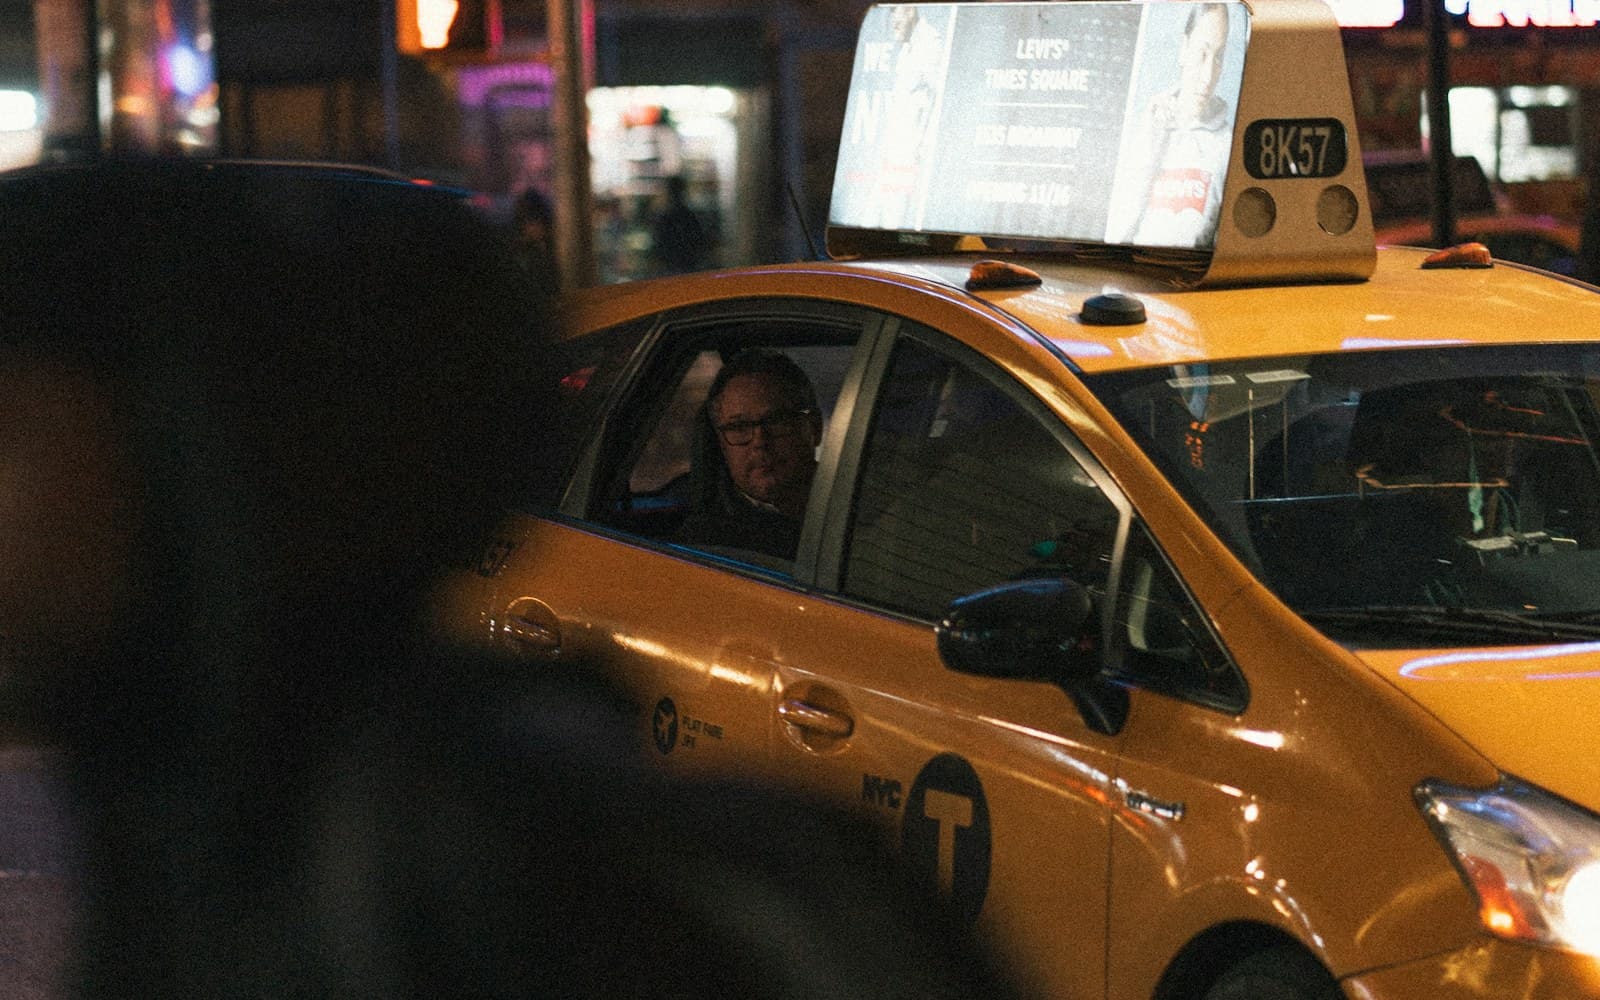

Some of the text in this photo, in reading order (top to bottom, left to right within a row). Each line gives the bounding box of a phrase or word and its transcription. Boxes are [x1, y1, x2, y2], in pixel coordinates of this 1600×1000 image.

[984, 68, 1091, 92] TIMES SQUARE
[1259, 125, 1332, 177] 8K57
[863, 773, 902, 809] NYC
